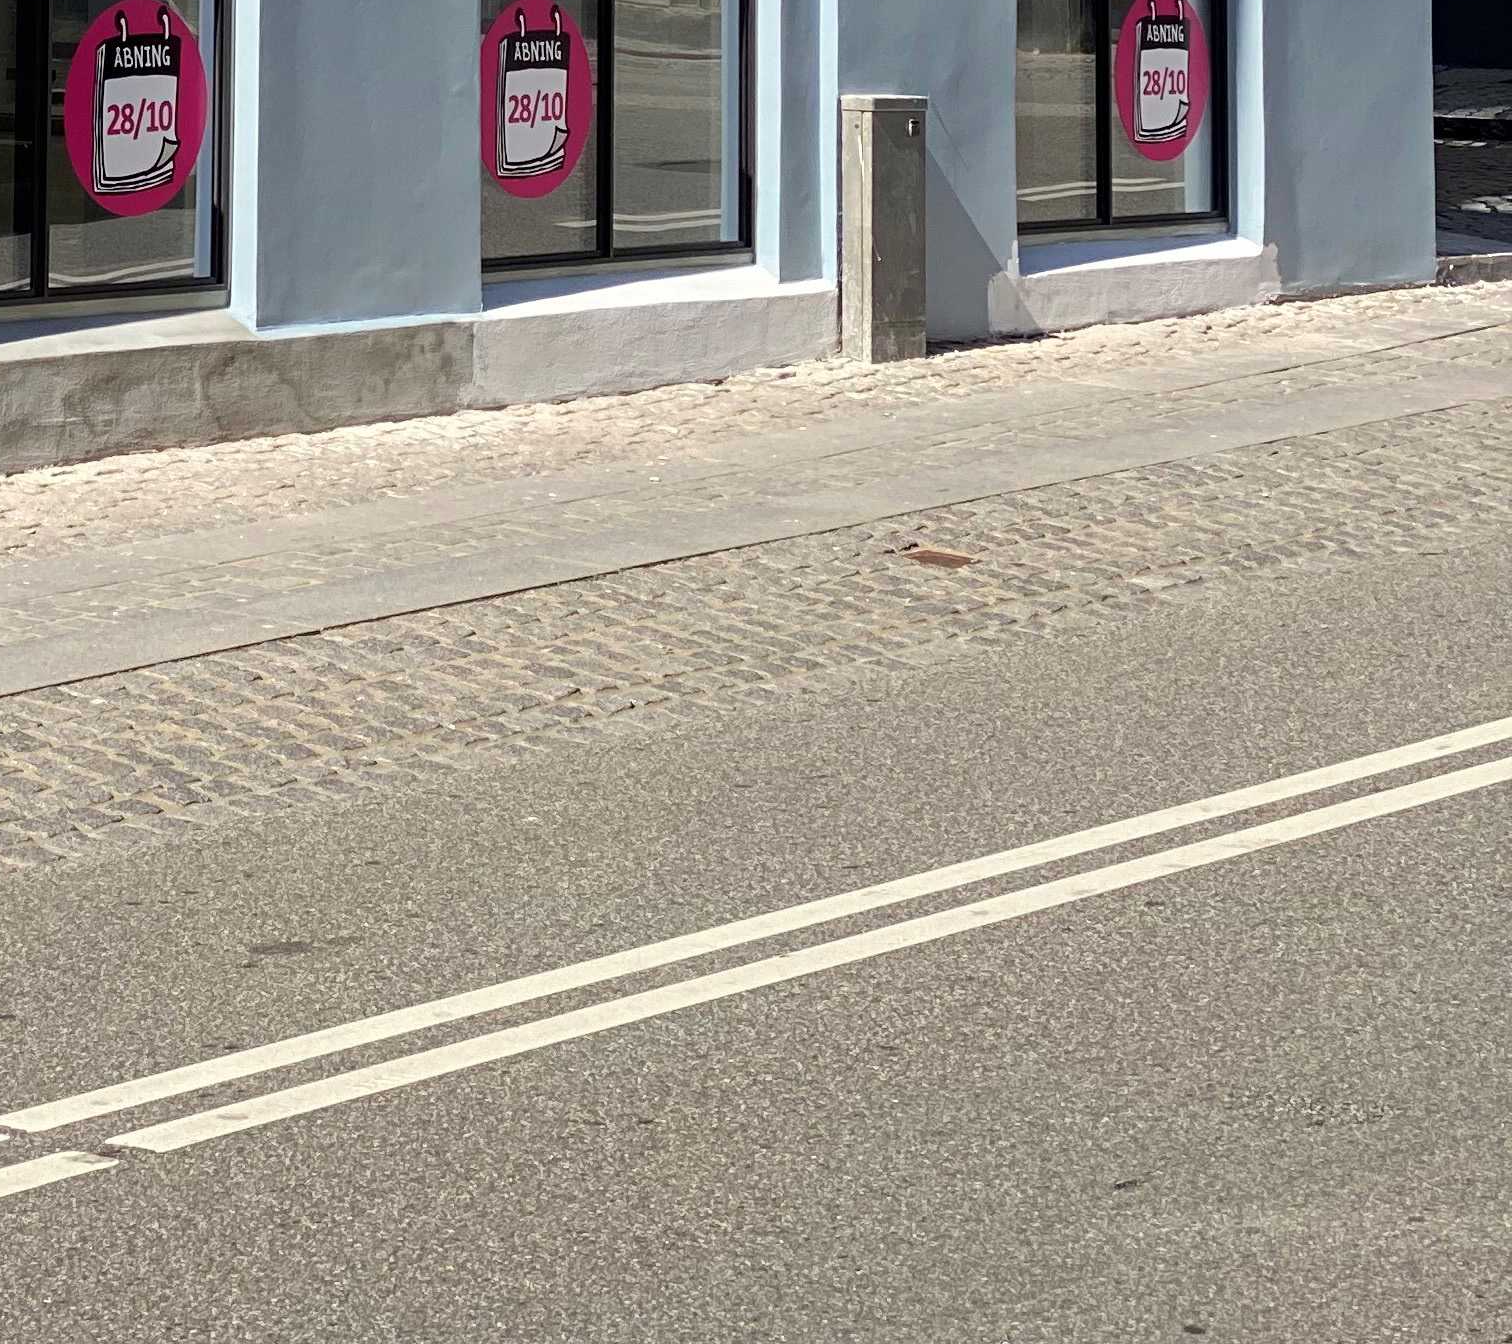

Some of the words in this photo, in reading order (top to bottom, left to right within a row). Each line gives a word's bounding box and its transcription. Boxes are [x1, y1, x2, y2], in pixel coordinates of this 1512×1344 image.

[113, 44, 171, 69] ÅBNING
[1143, 67, 1186, 100] 28/10
[107, 98, 173, 140] 28/10
[508, 89, 564, 129] 28/10
